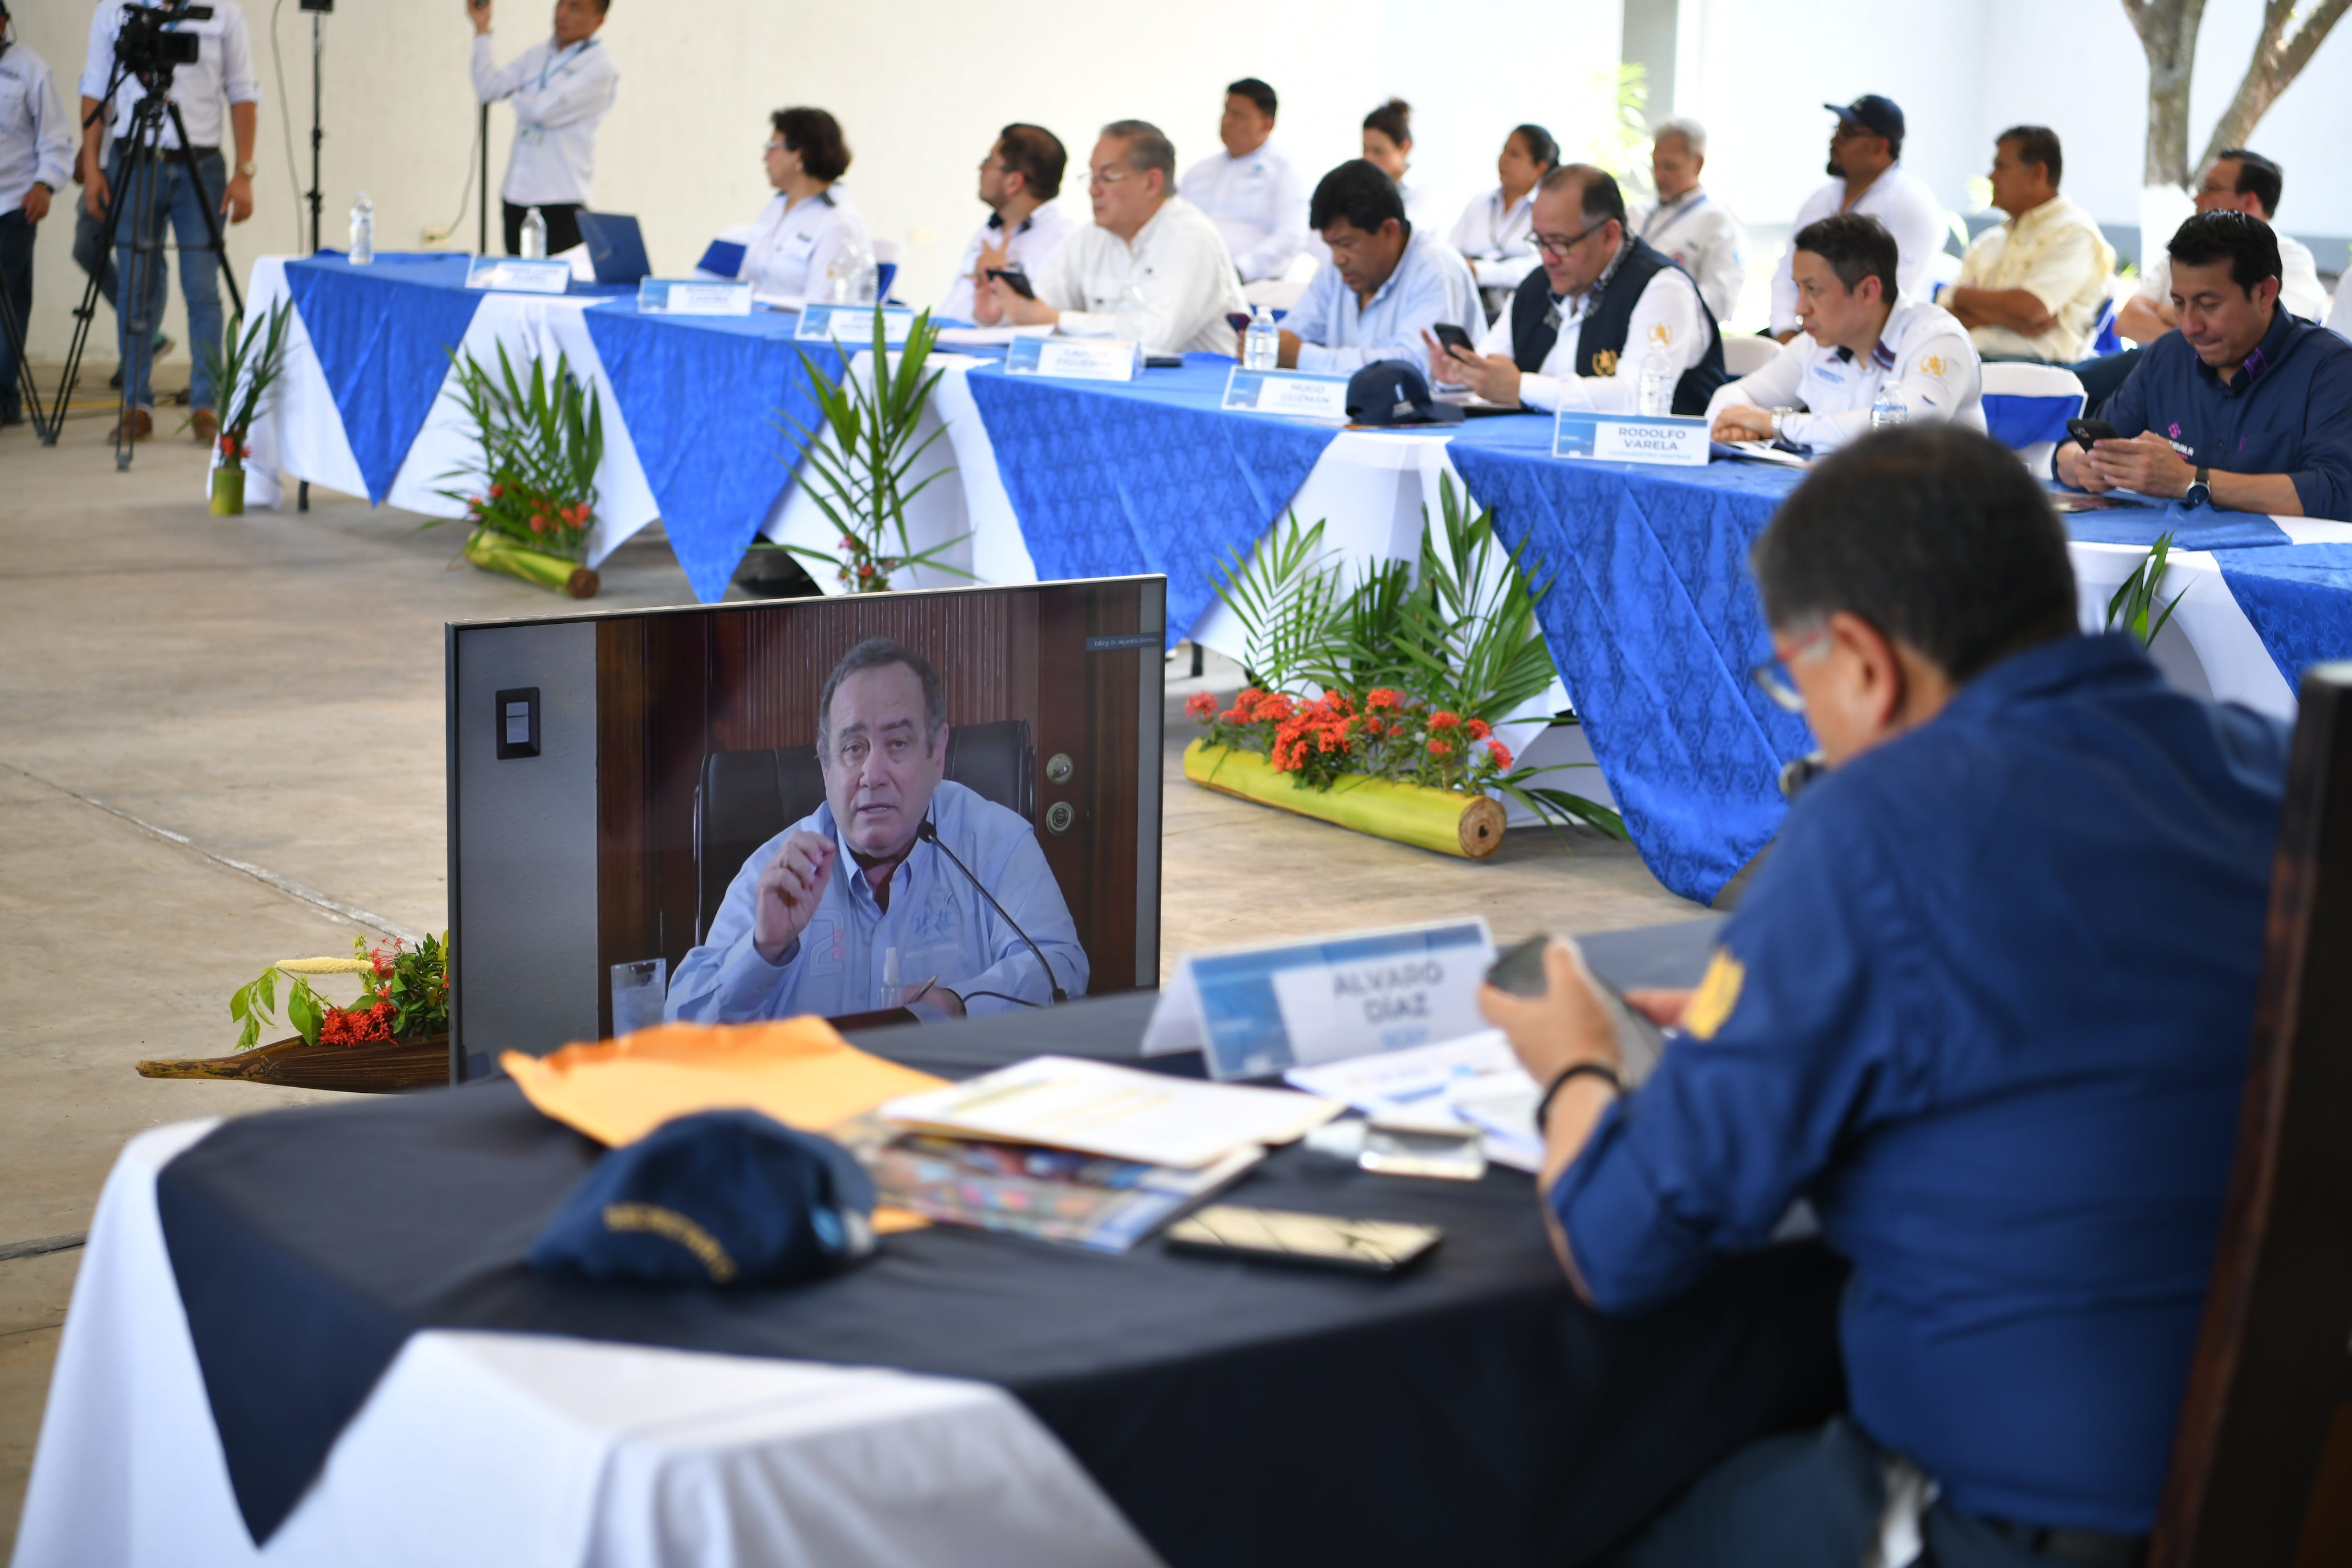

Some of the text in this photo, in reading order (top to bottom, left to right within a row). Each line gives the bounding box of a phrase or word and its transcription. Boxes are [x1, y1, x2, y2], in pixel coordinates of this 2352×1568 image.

[1291, 383, 1325, 394] HUGO
[1619, 427, 1686, 439] RODOLFO
[1624, 439, 1678, 451] VARELA
[1334, 959, 1445, 999] ALVARO
